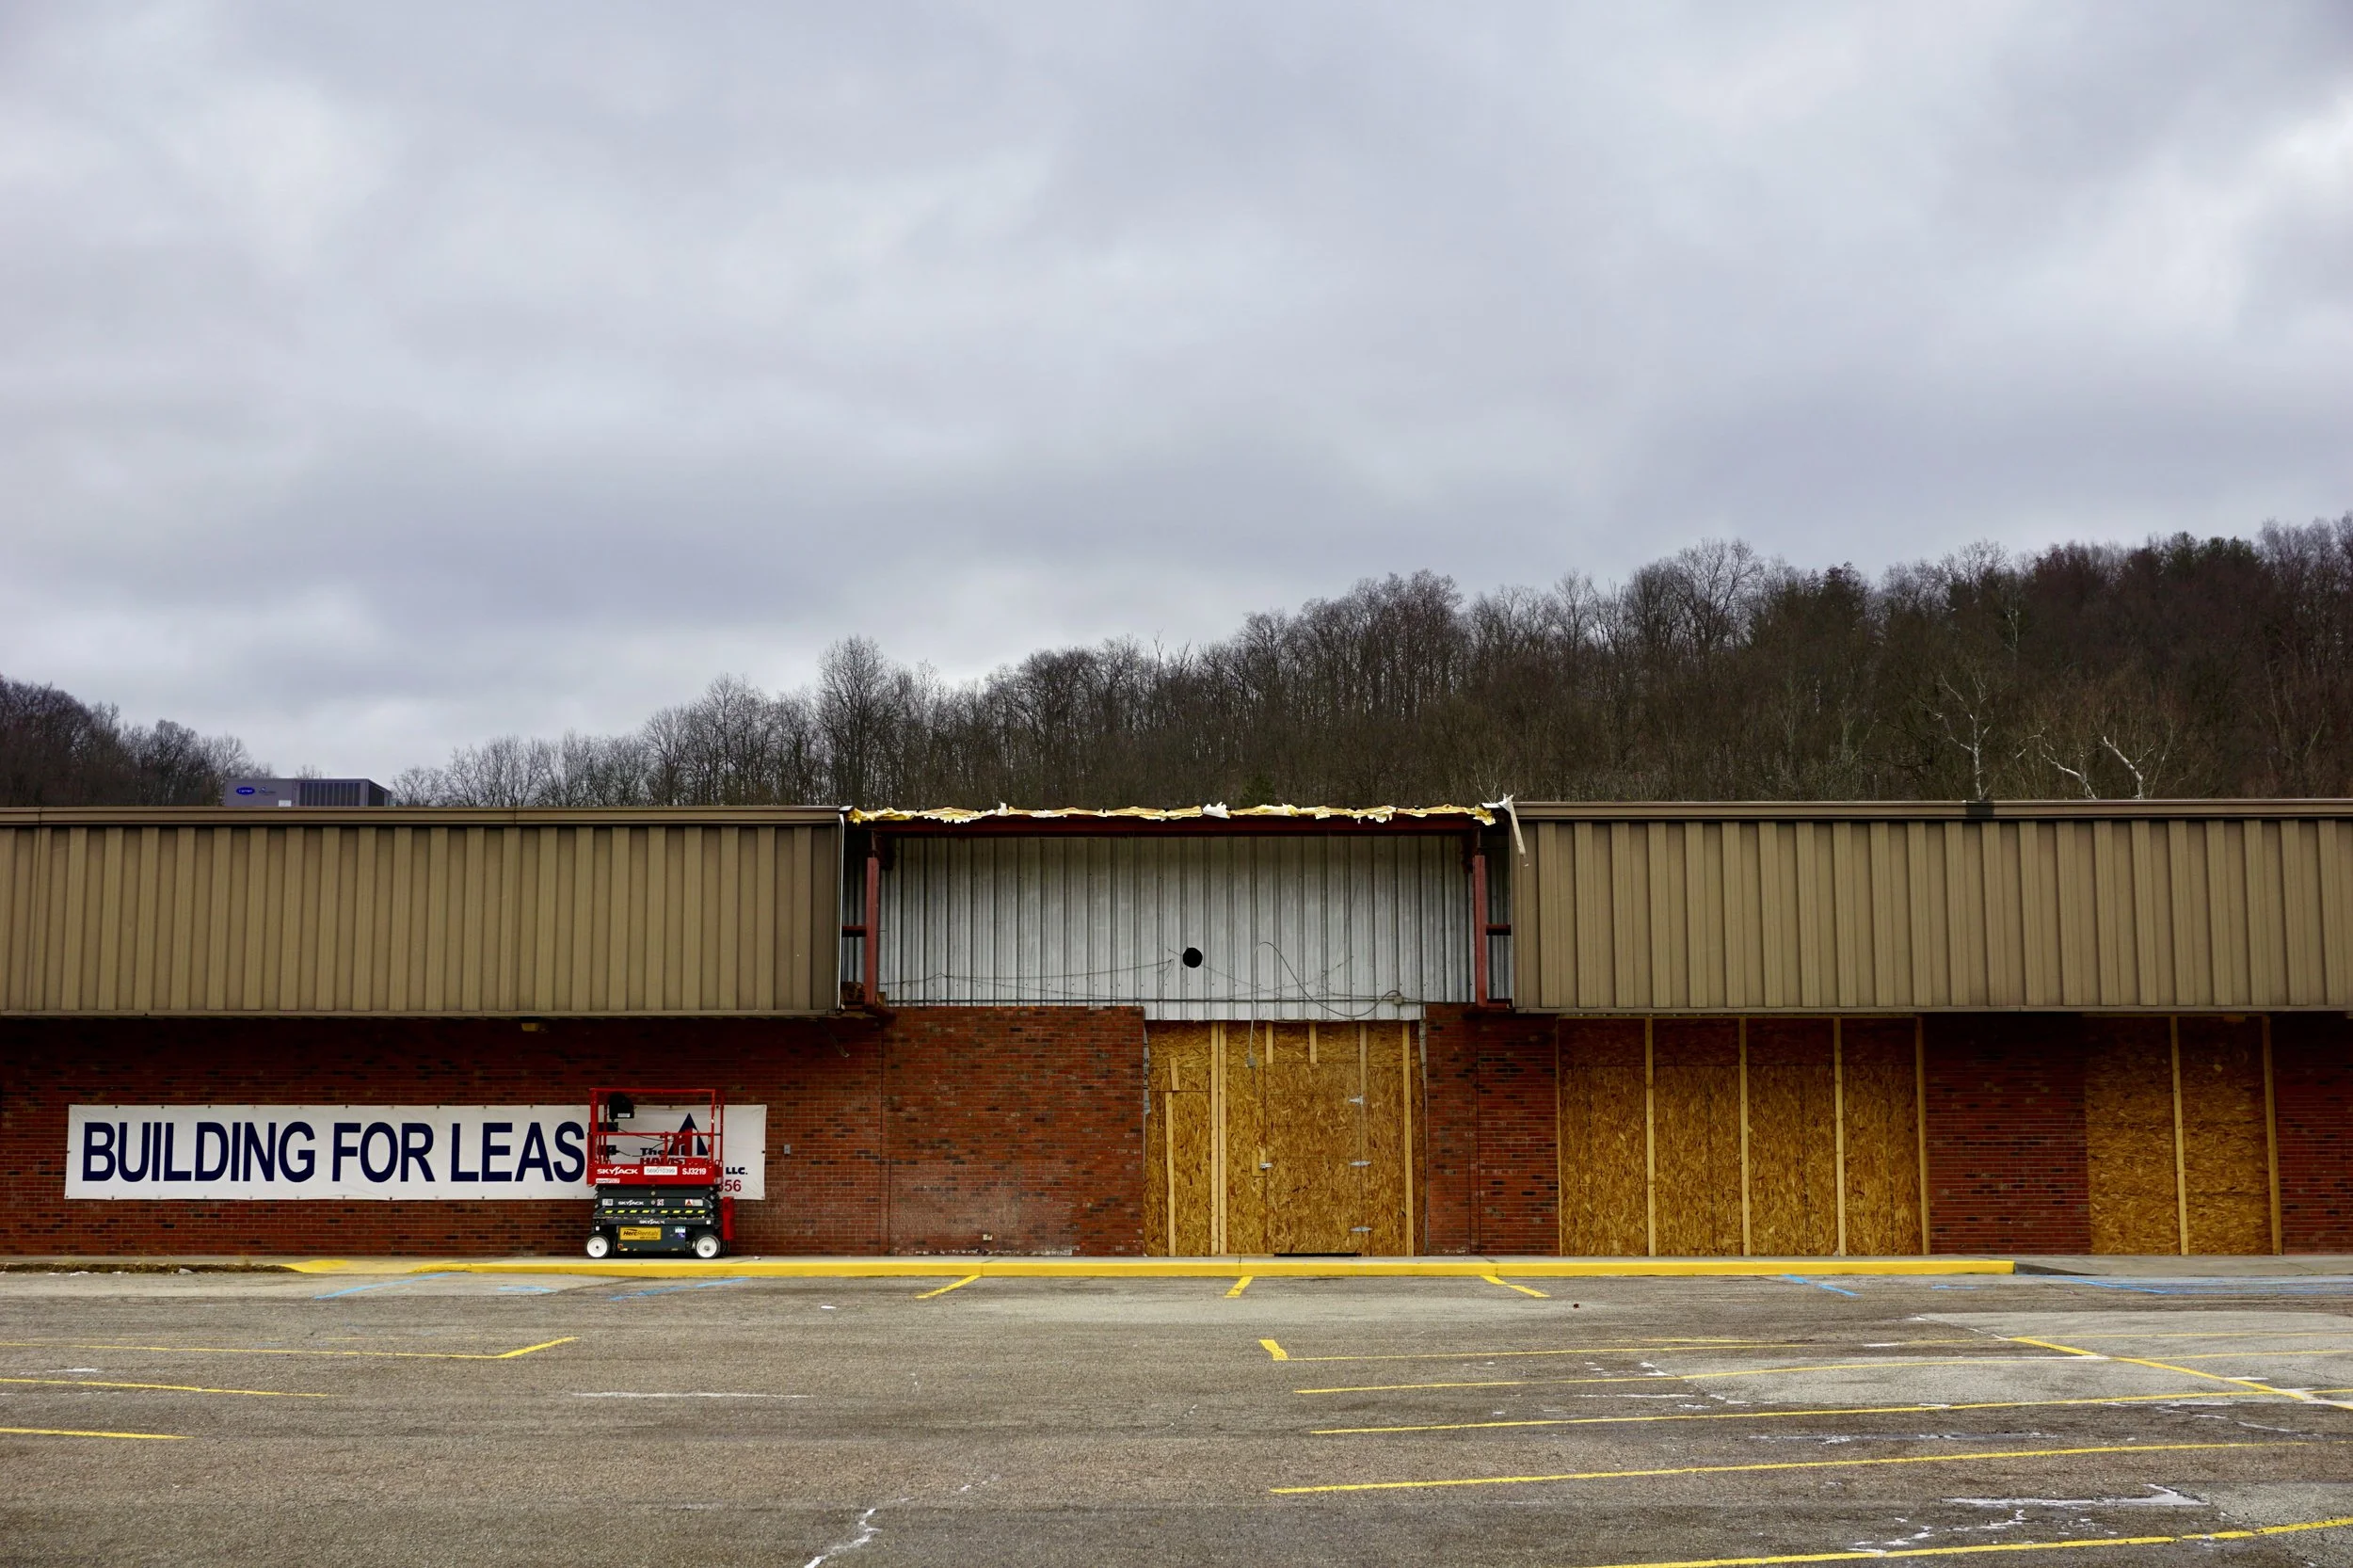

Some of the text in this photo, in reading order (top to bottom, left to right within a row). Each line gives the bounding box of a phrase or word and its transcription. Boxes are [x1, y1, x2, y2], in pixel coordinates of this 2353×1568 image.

[82, 1121, 315, 1183] BUILDING
[332, 1121, 436, 1183] FOR
[597, 1165, 639, 1176] SKYJACK
[681, 1167, 707, 1176] SJ3219
[726, 1166, 748, 1176] LLC.
